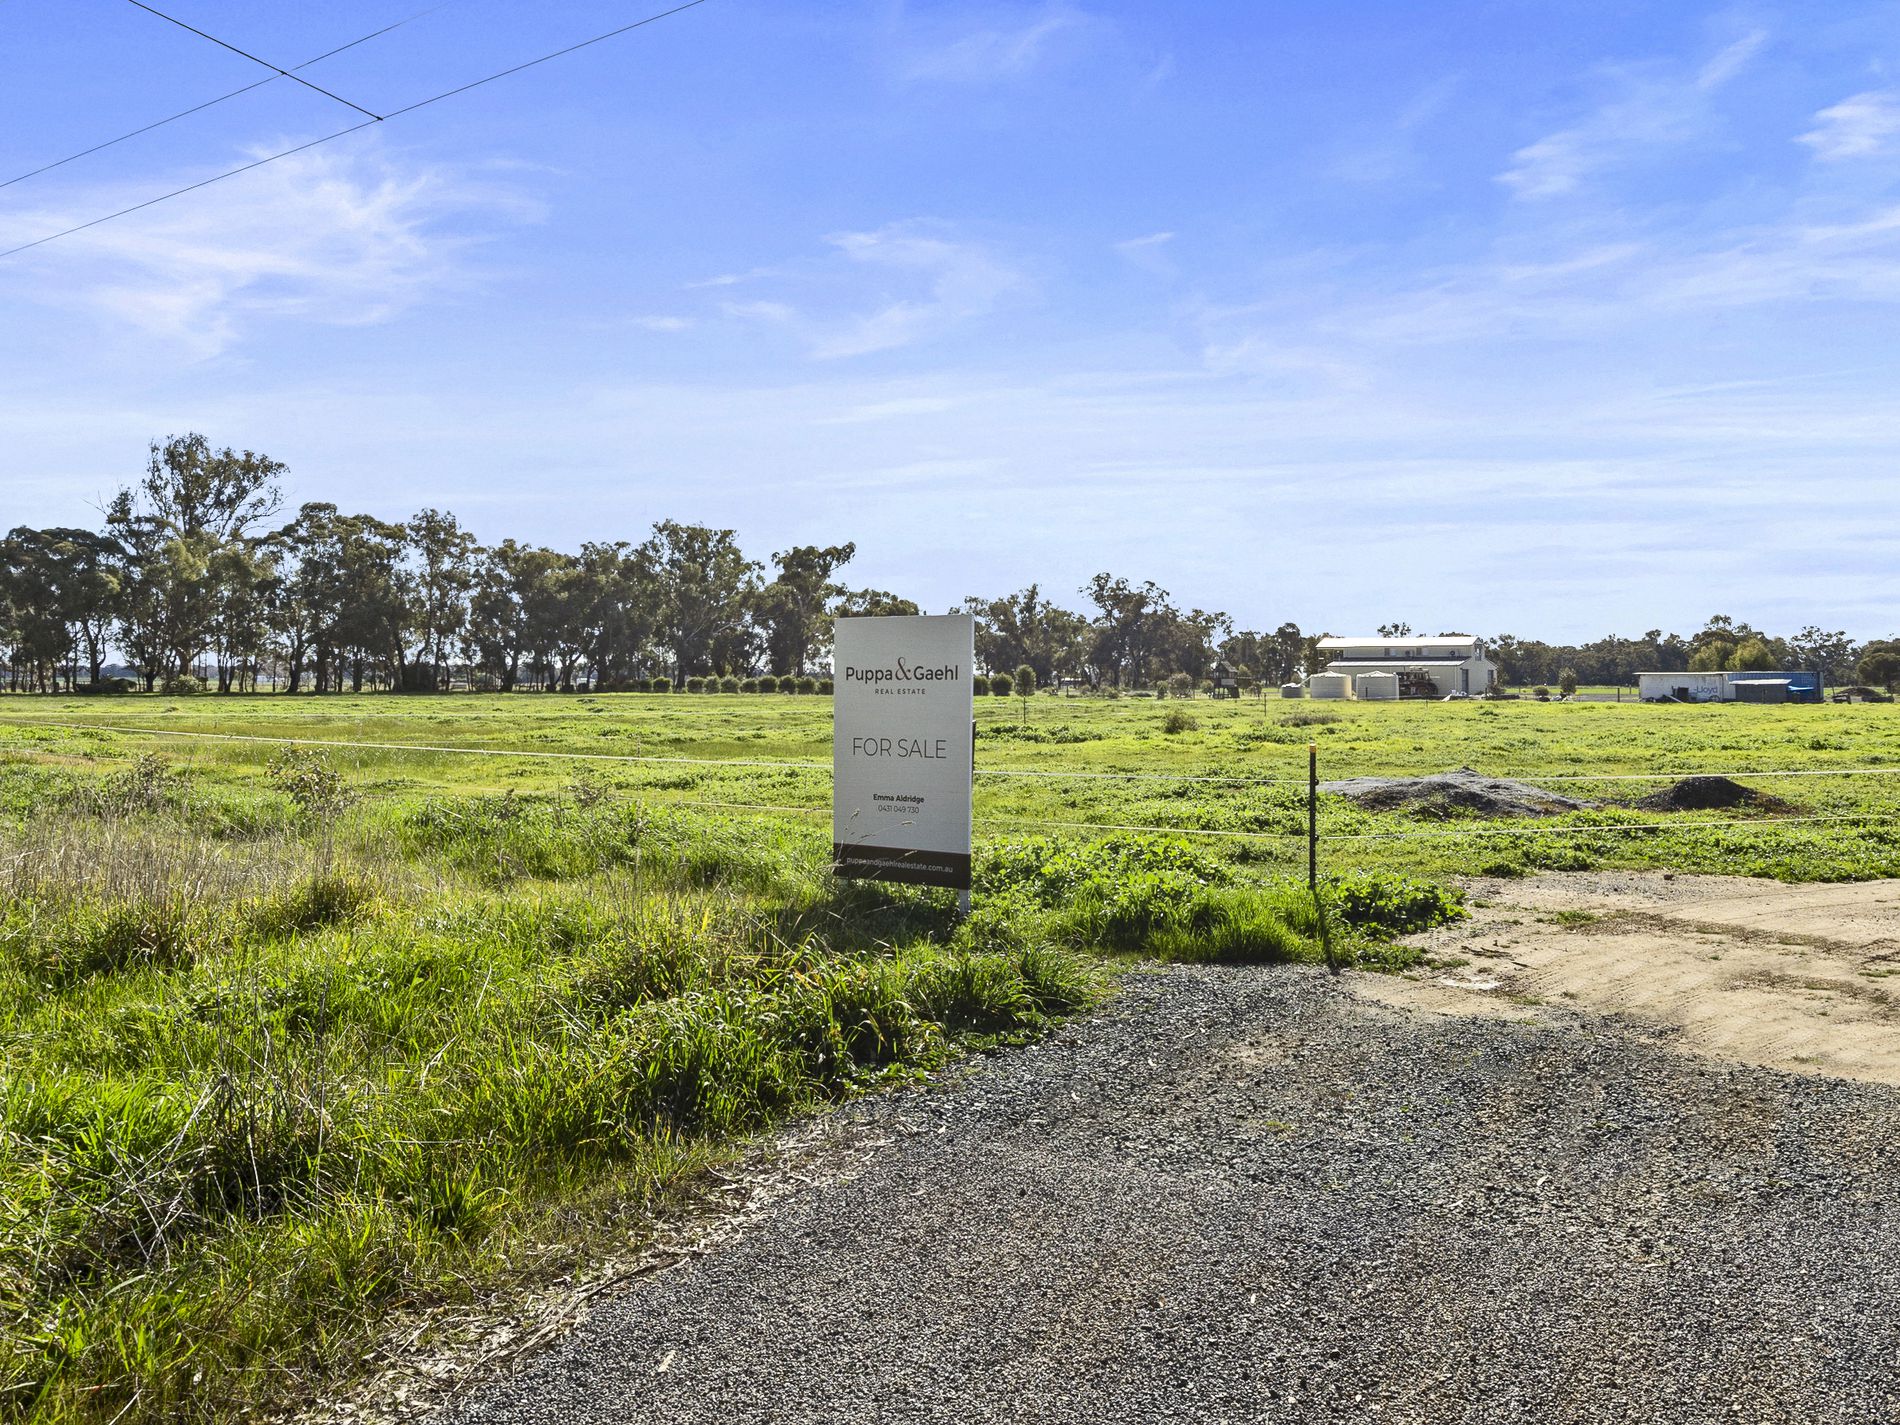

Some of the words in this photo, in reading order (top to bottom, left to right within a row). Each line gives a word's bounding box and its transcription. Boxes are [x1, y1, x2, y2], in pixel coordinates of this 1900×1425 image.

[853, 737, 892, 757] FOR
[897, 738, 947, 759] SALE
[873, 793, 895, 802] Emma
[895, 794, 925, 804] Aldridge
